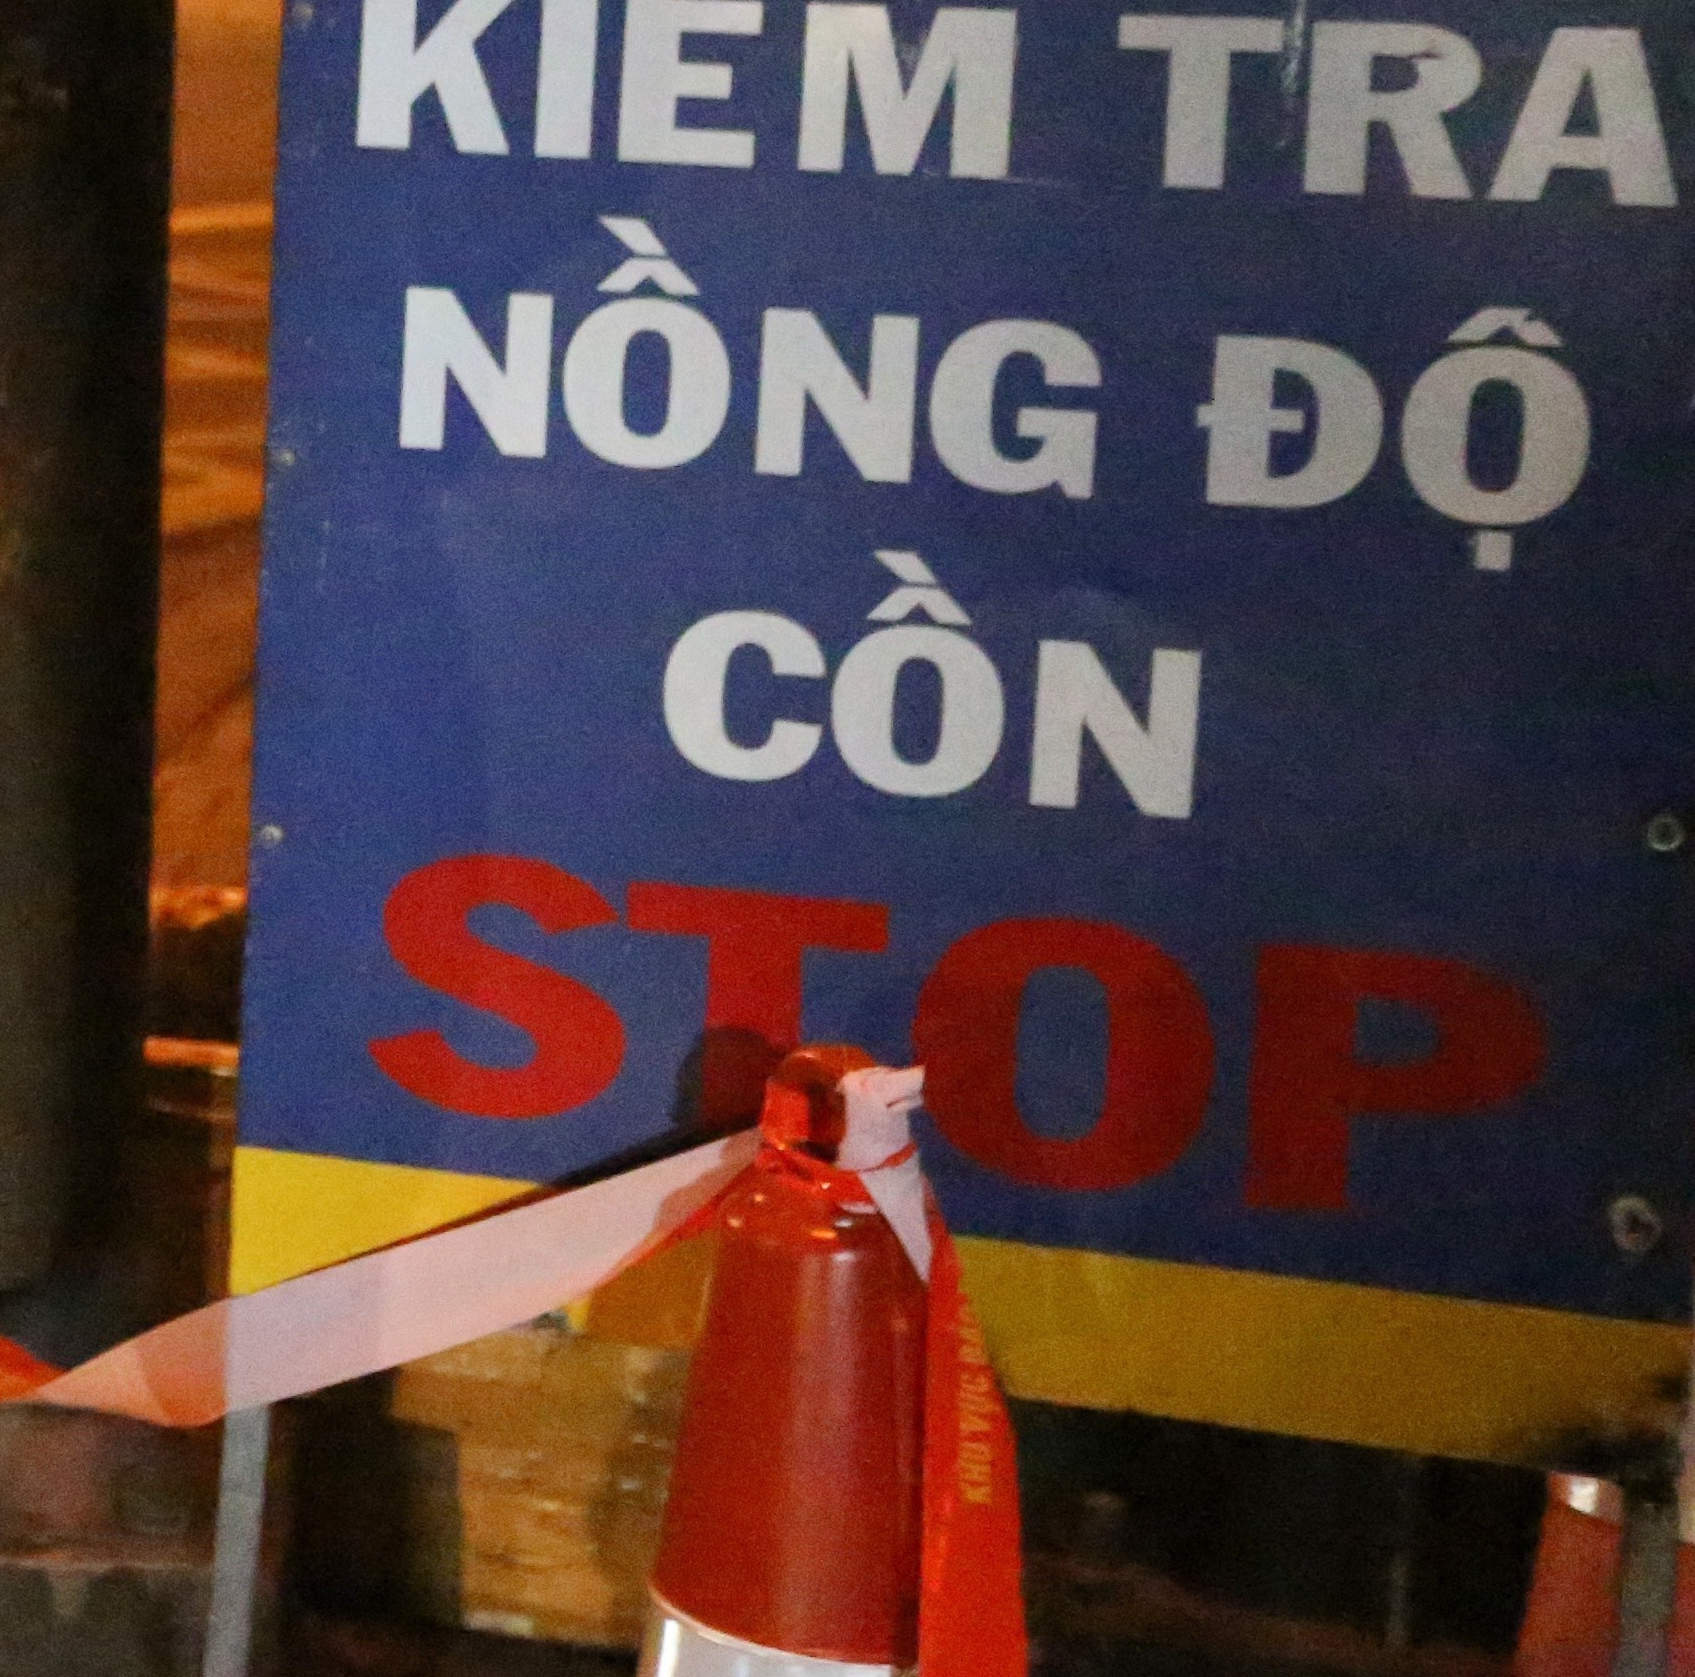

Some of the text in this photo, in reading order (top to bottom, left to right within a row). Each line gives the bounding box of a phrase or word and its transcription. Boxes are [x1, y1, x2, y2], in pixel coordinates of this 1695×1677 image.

[1116, 14, 1679, 208] TRA
[398, 216, 1592, 573] NỒNG ĐỘ
[662, 549, 1203, 820] CỒN
[367, 853, 1549, 1214] STOP
[958, 1442, 992, 1504] KHU
